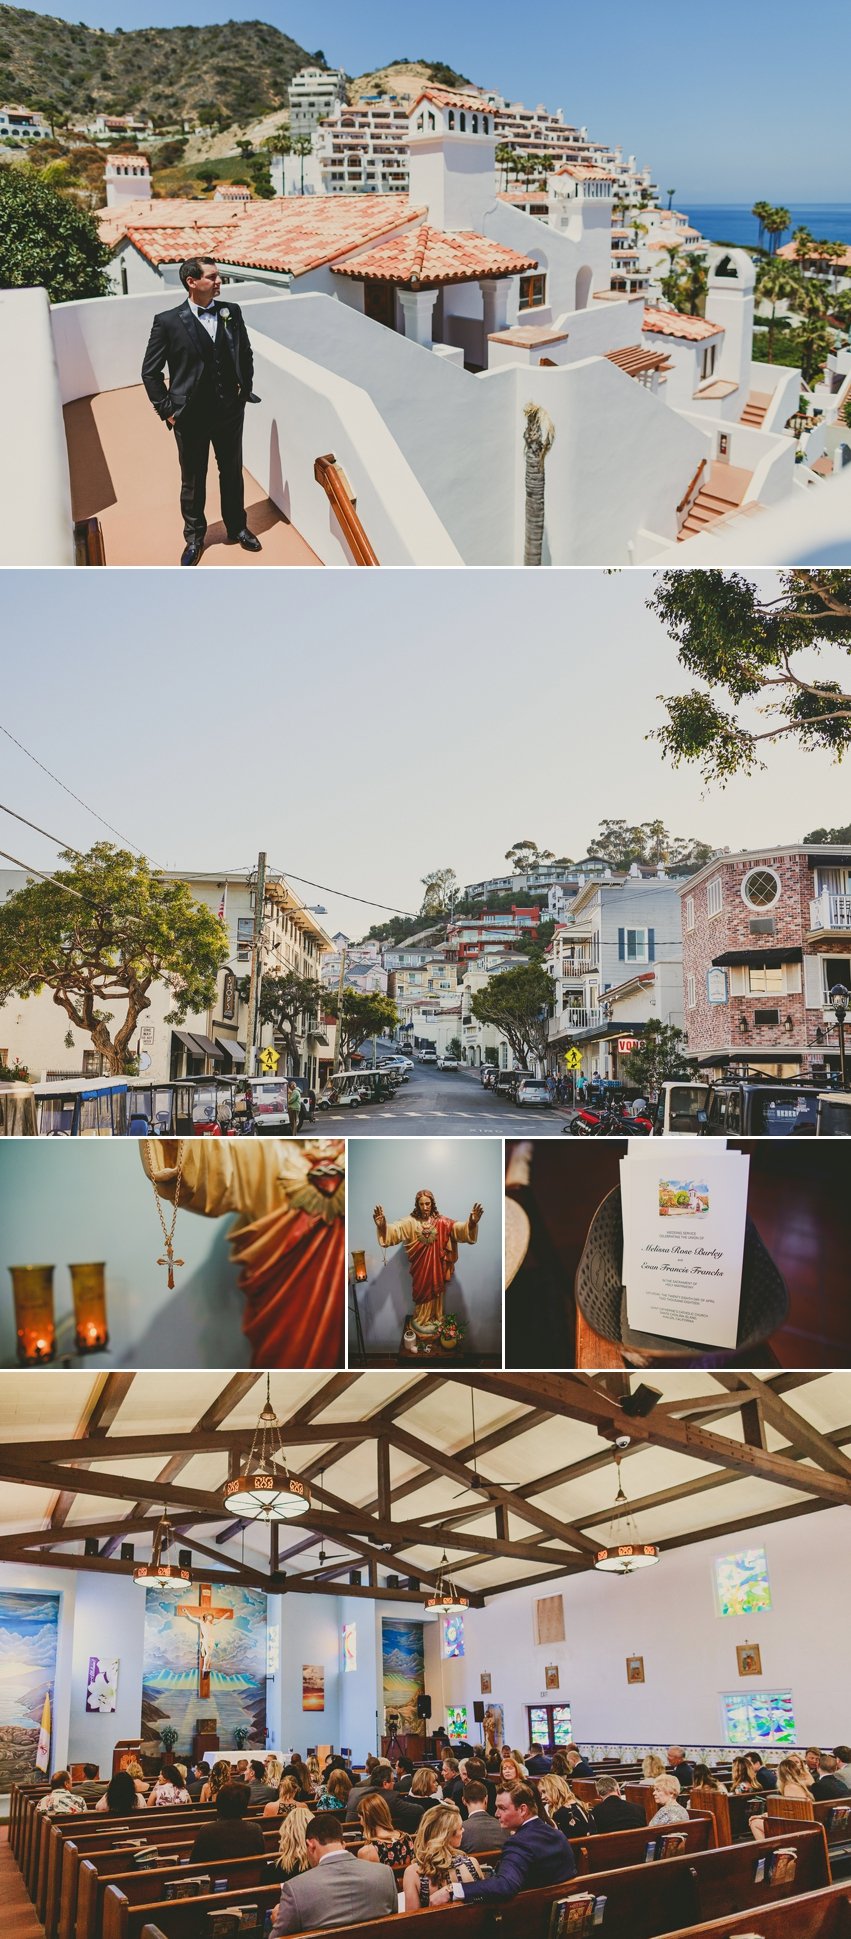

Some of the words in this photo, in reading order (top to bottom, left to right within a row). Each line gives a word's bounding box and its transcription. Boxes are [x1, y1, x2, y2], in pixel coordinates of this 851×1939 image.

[225, 976, 233, 1010] SHOPS
[620, 1040, 646, 1050] VONS
[641, 1244, 670, 1253] Melissa
[670, 1246, 693, 1255] Rose
[694, 1248, 723, 1259] Burley
[641, 1262, 658, 1270] Evan
[660, 1264, 689, 1274] Francis
[690, 1266, 724, 1277] Francks
